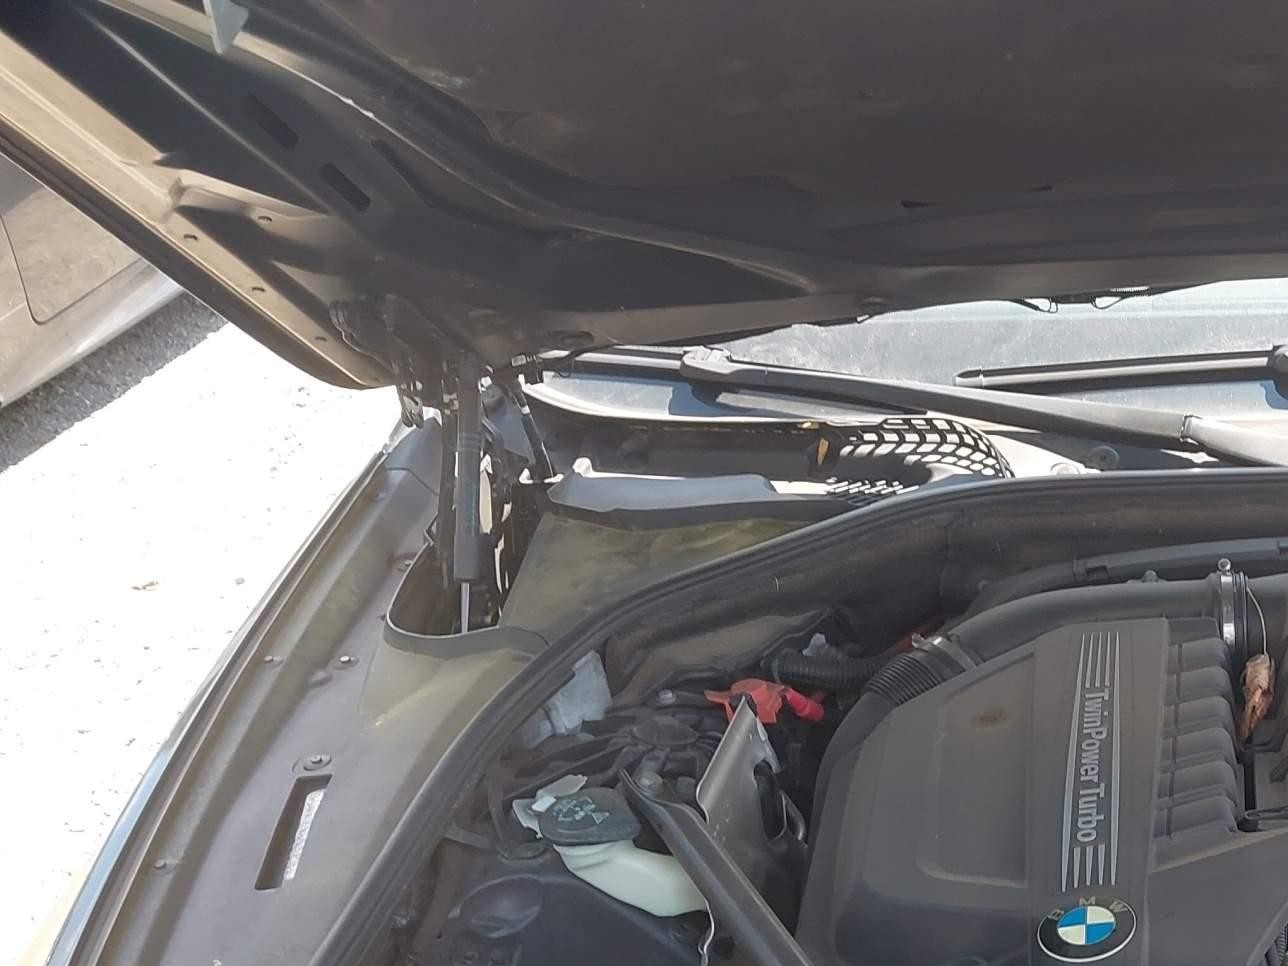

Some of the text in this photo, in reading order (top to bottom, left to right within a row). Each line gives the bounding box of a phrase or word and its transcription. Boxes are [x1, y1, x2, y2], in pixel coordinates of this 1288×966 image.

[1076, 686, 1109, 843] TwinPower Turbo
[1047, 895, 1129, 921] BMW
